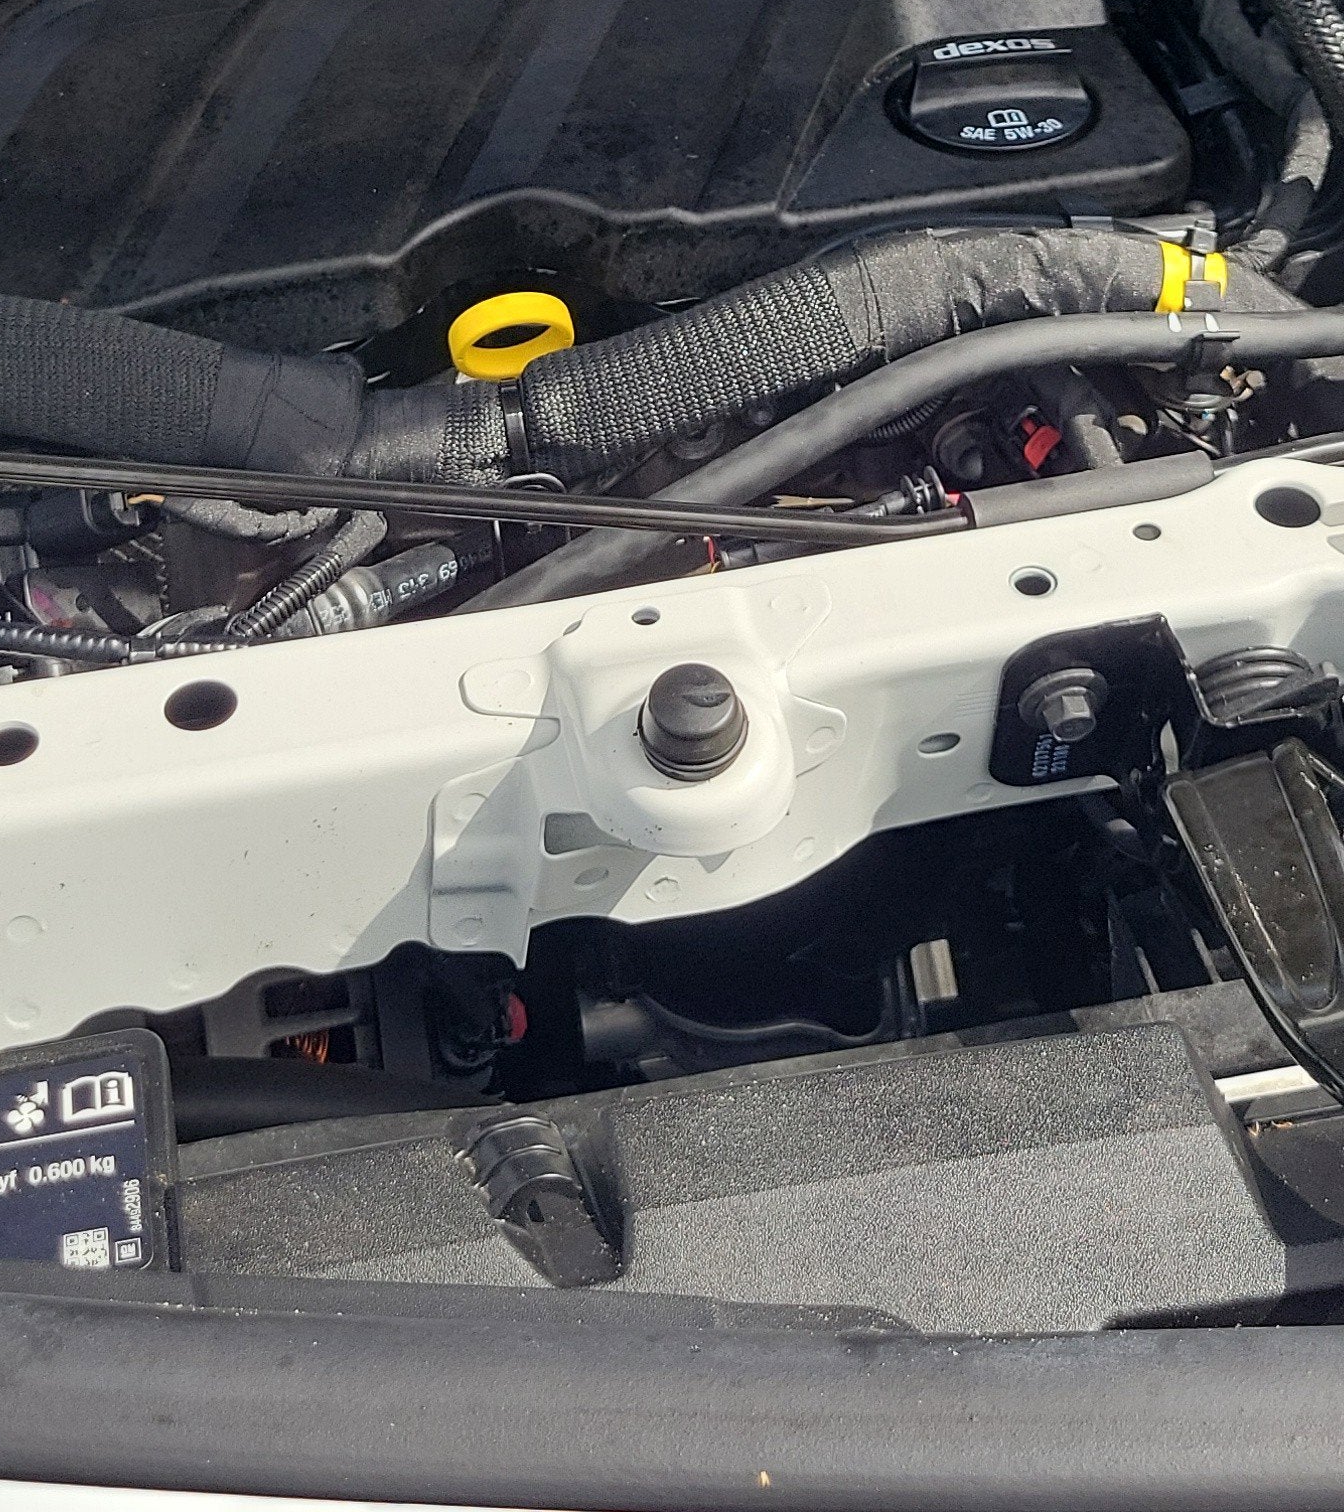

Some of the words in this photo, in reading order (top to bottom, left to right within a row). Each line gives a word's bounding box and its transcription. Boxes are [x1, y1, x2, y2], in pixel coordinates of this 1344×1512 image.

[933, 38, 1056, 60] dexos
[960, 125, 996, 142] SAE
[1004, 117, 1064, 141] 5W-30
[27, 1157, 86, 1186] 0.600
[89, 1154, 116, 1176] kg
[123, 1178, 143, 1232] 84492906
